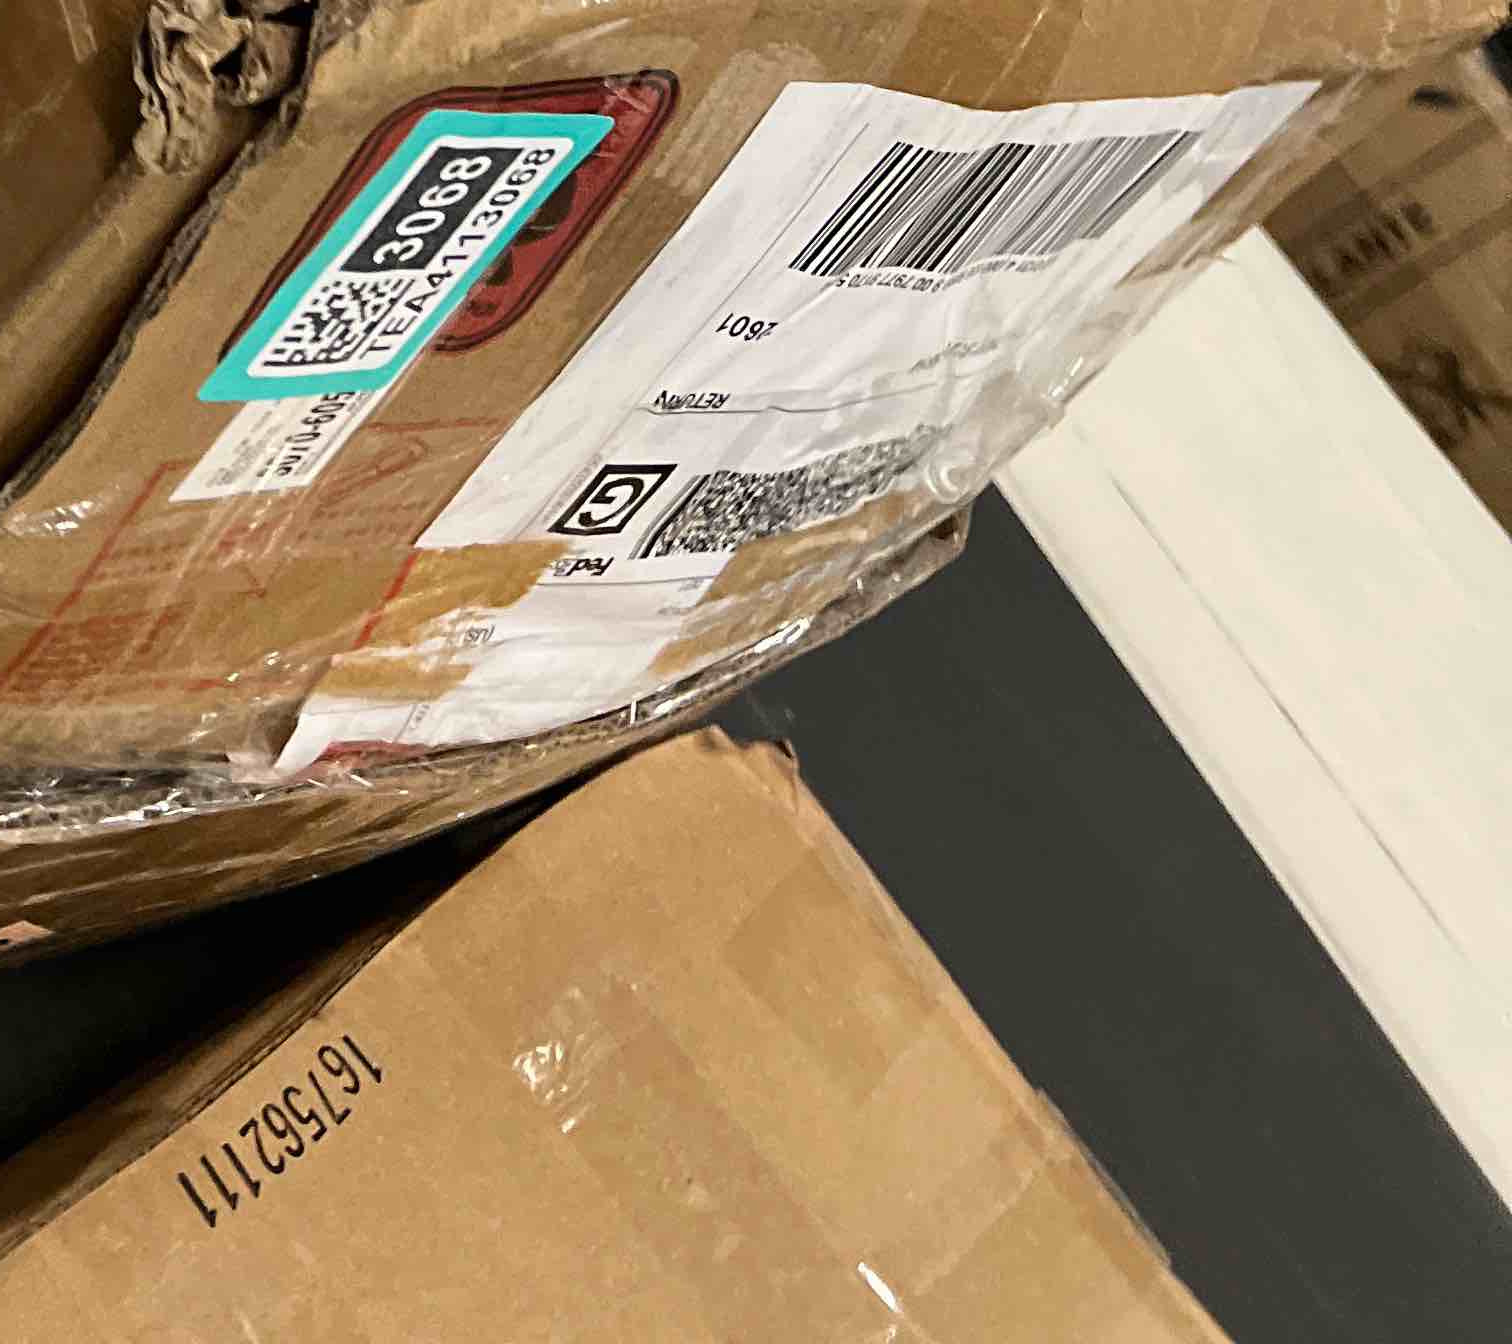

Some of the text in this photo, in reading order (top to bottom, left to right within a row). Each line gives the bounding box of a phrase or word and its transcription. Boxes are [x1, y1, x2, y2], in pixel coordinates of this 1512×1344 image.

[361, 147, 557, 361] TEA4113068
[372, 155, 493, 265] 3068
[653, 390, 731, 410] RETURN
[577, 476, 645, 528] G
[177, 1034, 383, 1229] 167562111
